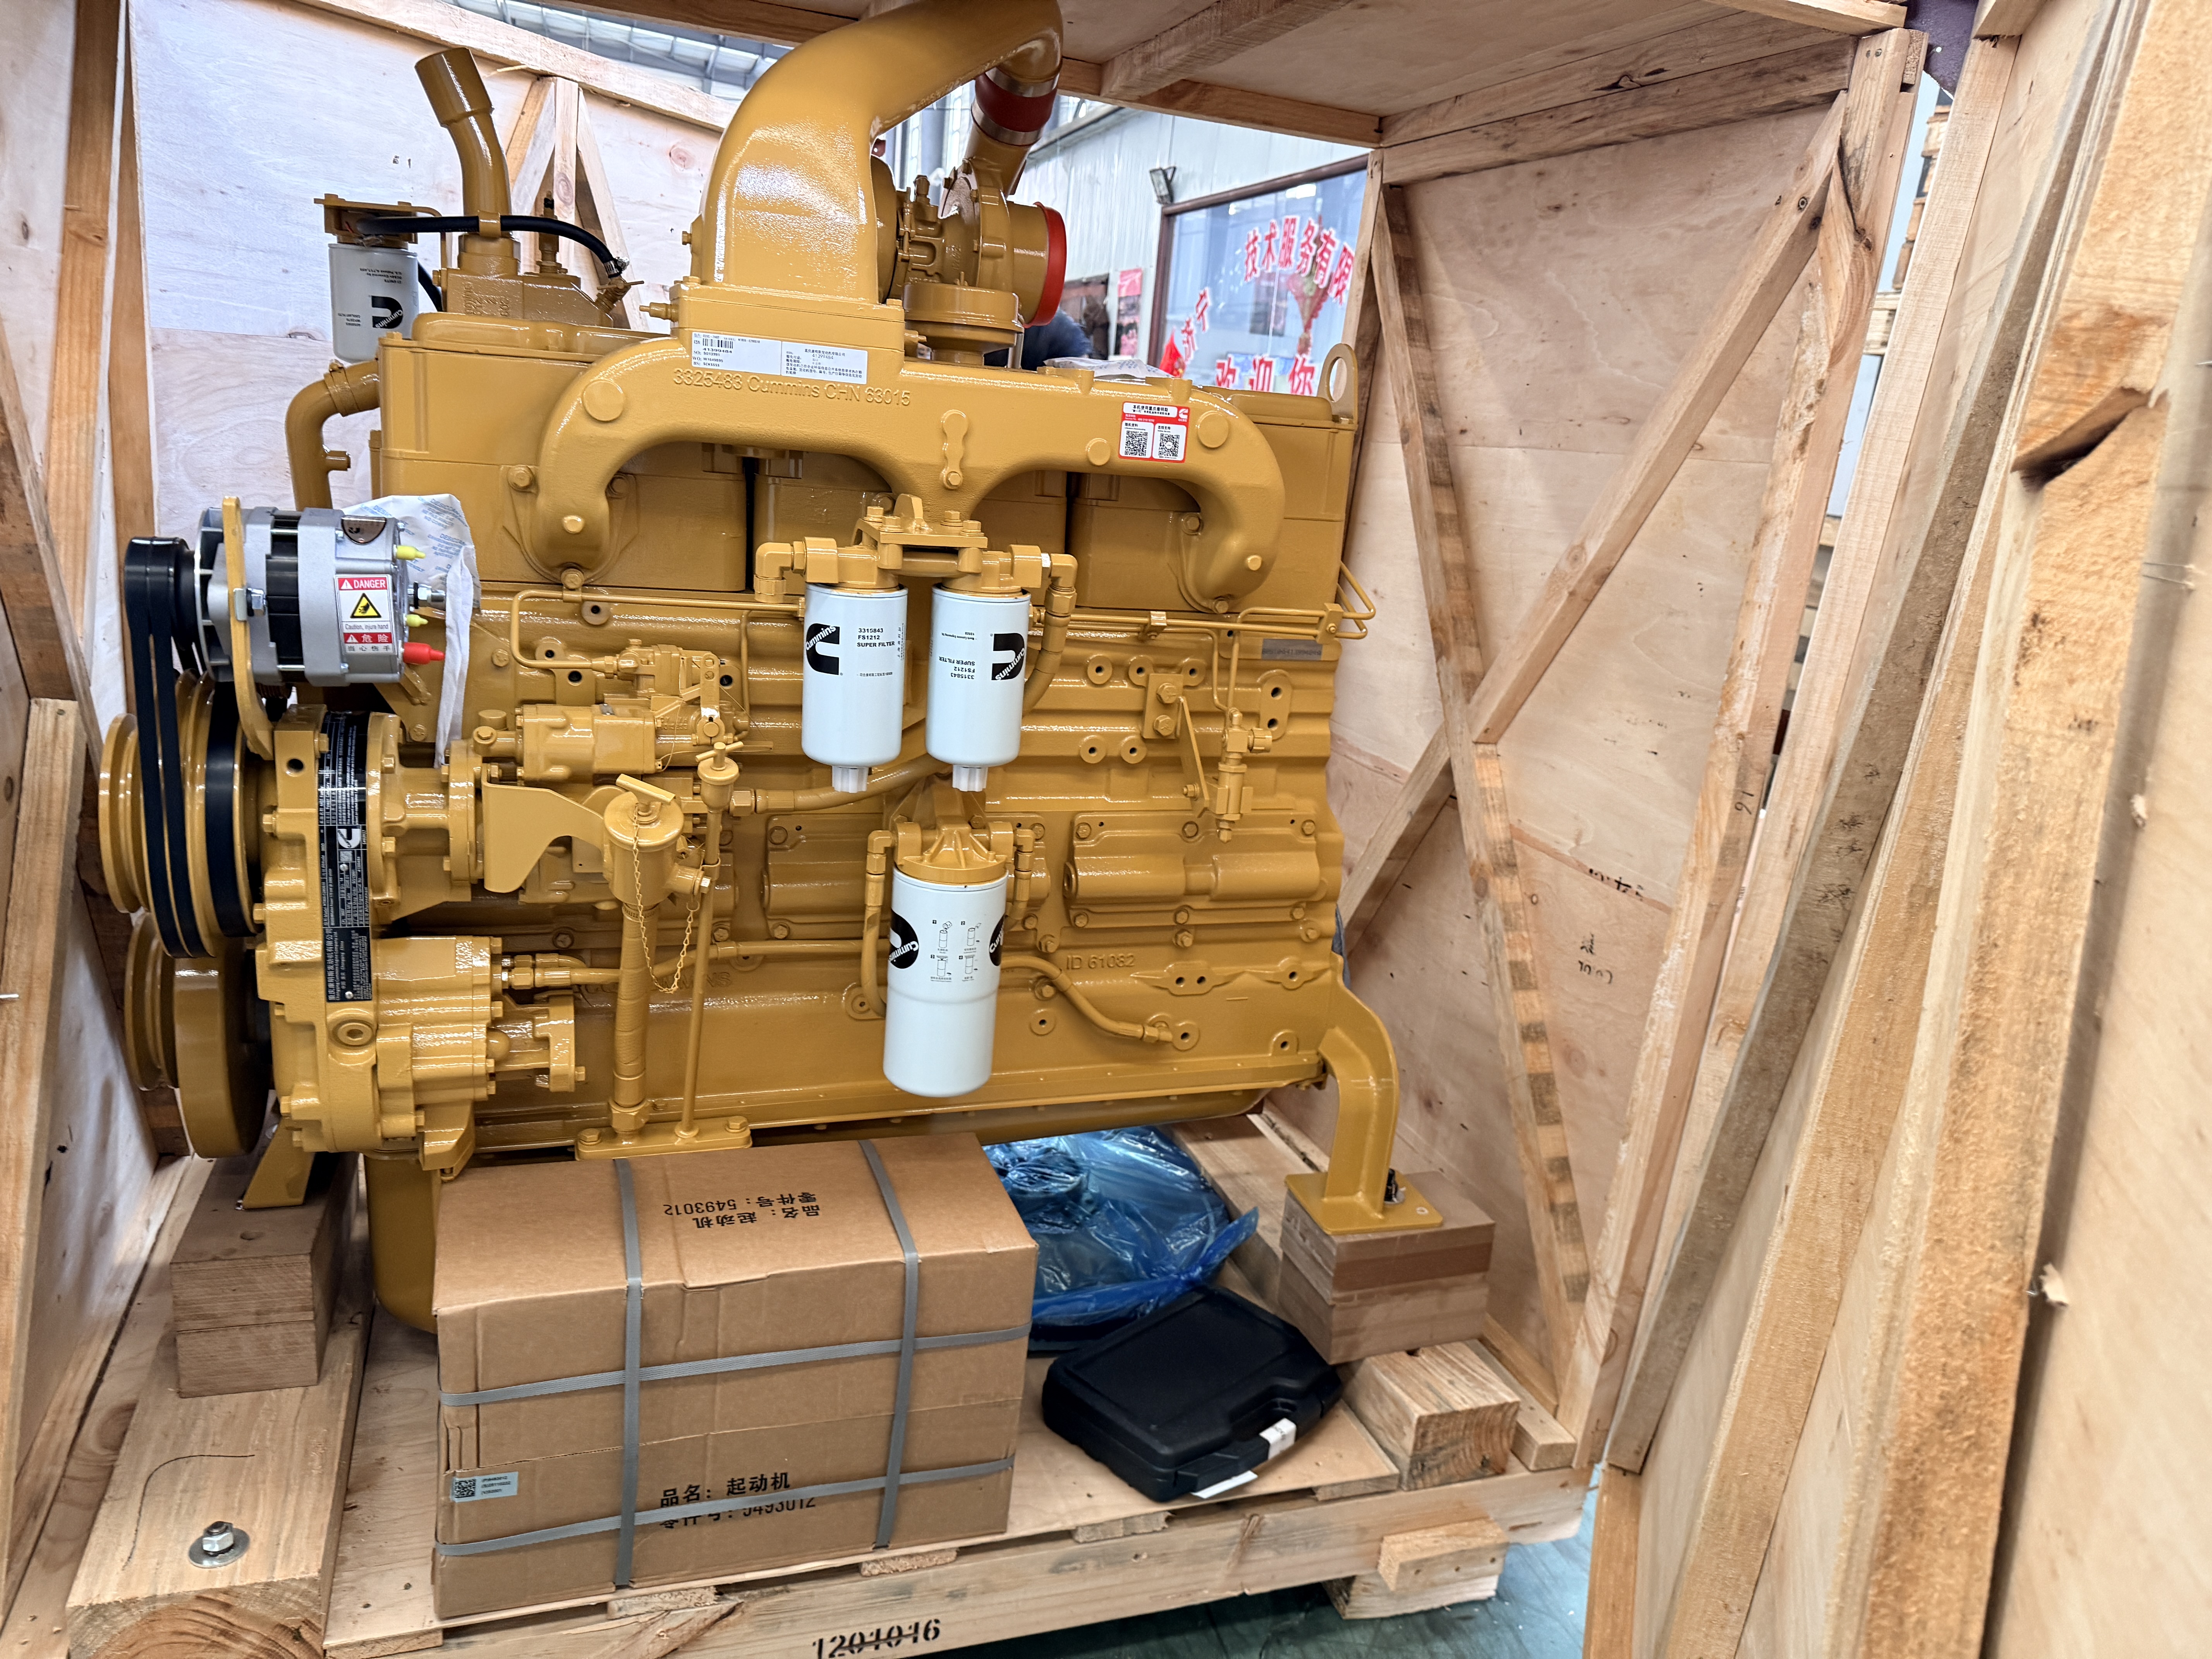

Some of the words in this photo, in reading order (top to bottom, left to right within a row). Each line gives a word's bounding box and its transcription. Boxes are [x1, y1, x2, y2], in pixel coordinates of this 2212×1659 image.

[375, 309, 403, 328] Cummins
[673, 368, 743, 390] 3325483
[747, 374, 820, 398] Cummins
[824, 383, 860, 402] CHN
[865, 386, 910, 405] 63015
[354, 579, 385, 588] DANGER
[362, 634, 388, 643] 危险
[806, 626, 836, 651] Cummins
[995, 647, 1025, 680] Cummins
[1066, 955, 1082, 970] ID
[812, 1619, 940, 1659] 1201016
